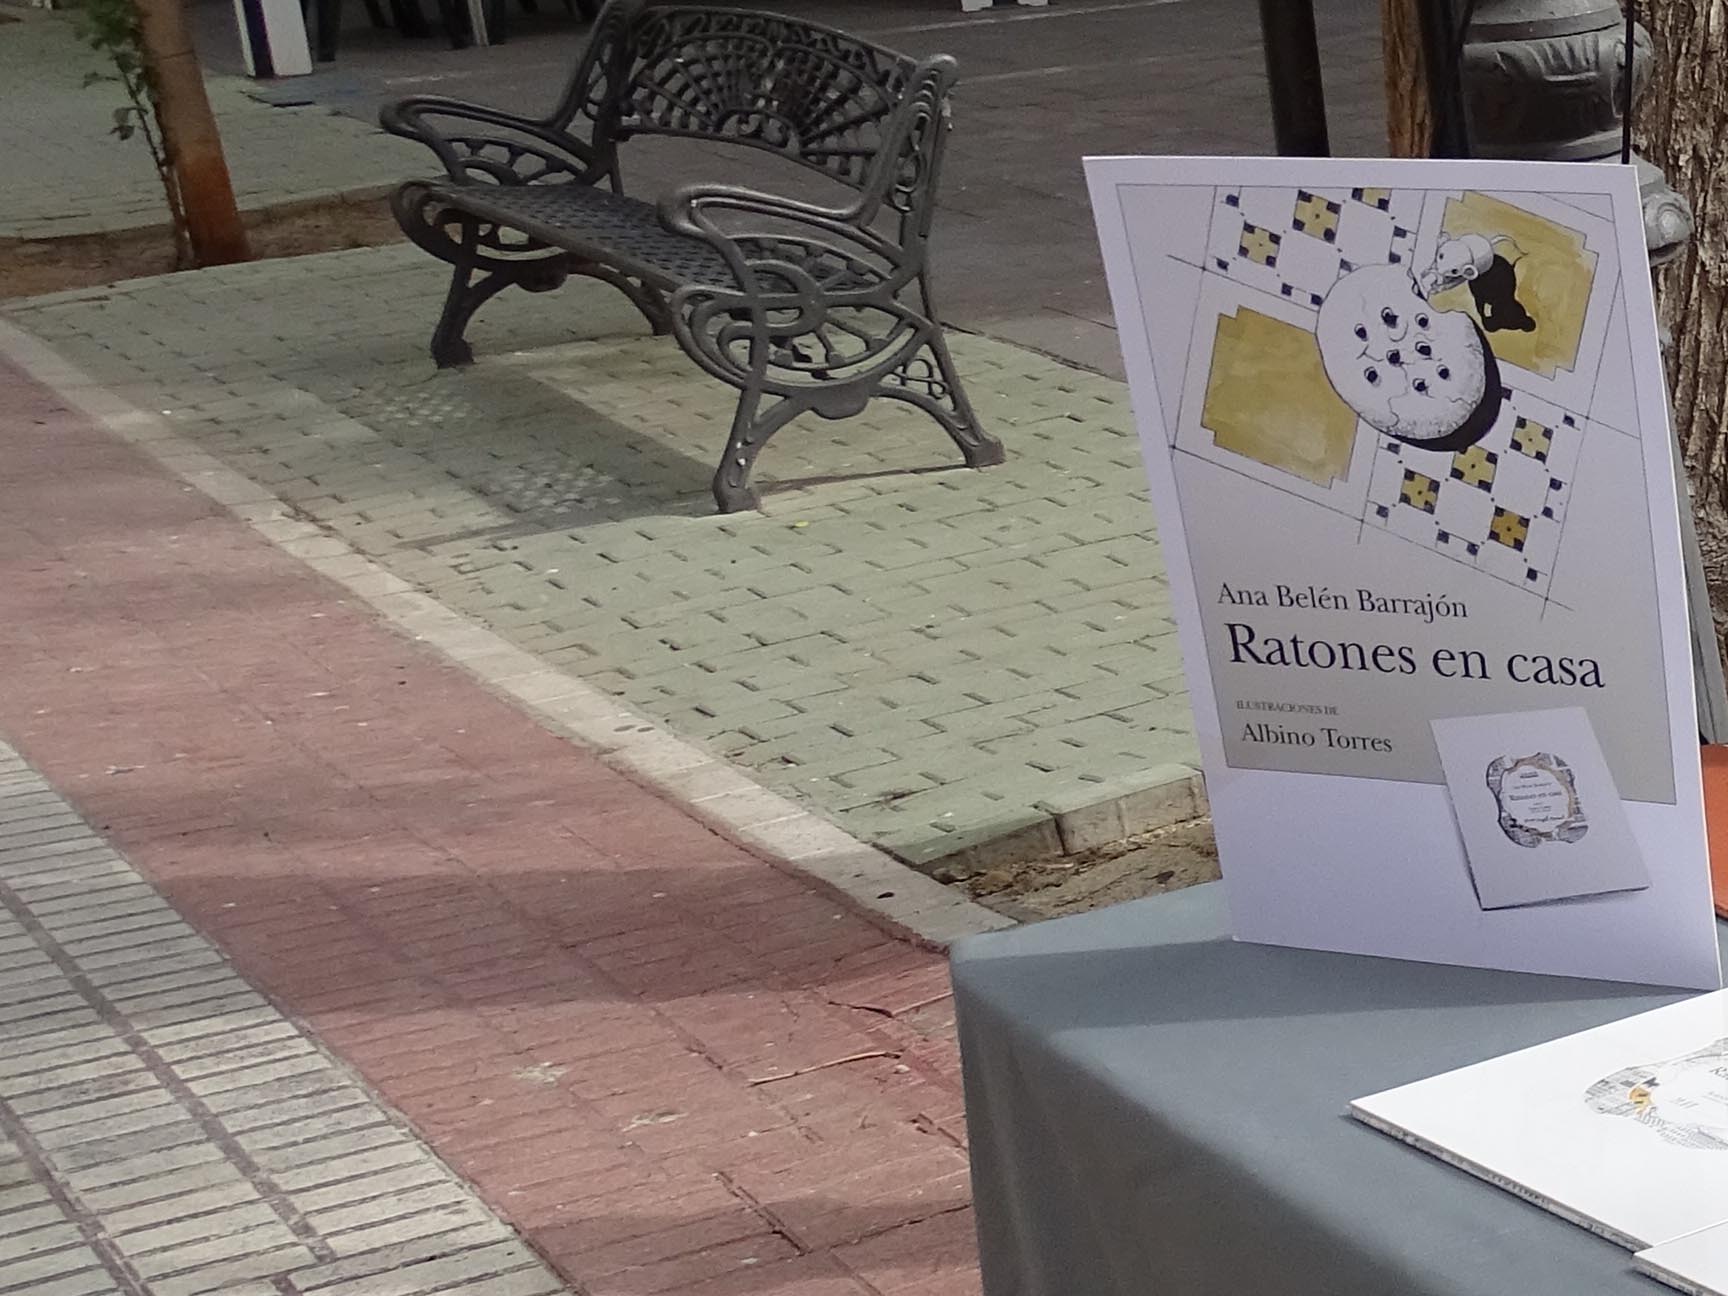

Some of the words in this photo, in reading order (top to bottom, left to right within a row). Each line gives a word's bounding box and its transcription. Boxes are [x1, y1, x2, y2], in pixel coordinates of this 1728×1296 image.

[1217, 582, 1268, 606] Ana
[1277, 585, 1348, 611] Belén
[1357, 588, 1469, 624] Barrajón
[1225, 622, 1416, 675] Ratones
[1432, 646, 1492, 681] en
[1507, 652, 1606, 689] casa
[1242, 722, 1316, 748] Albino
[1320, 727, 1393, 752] Torres
